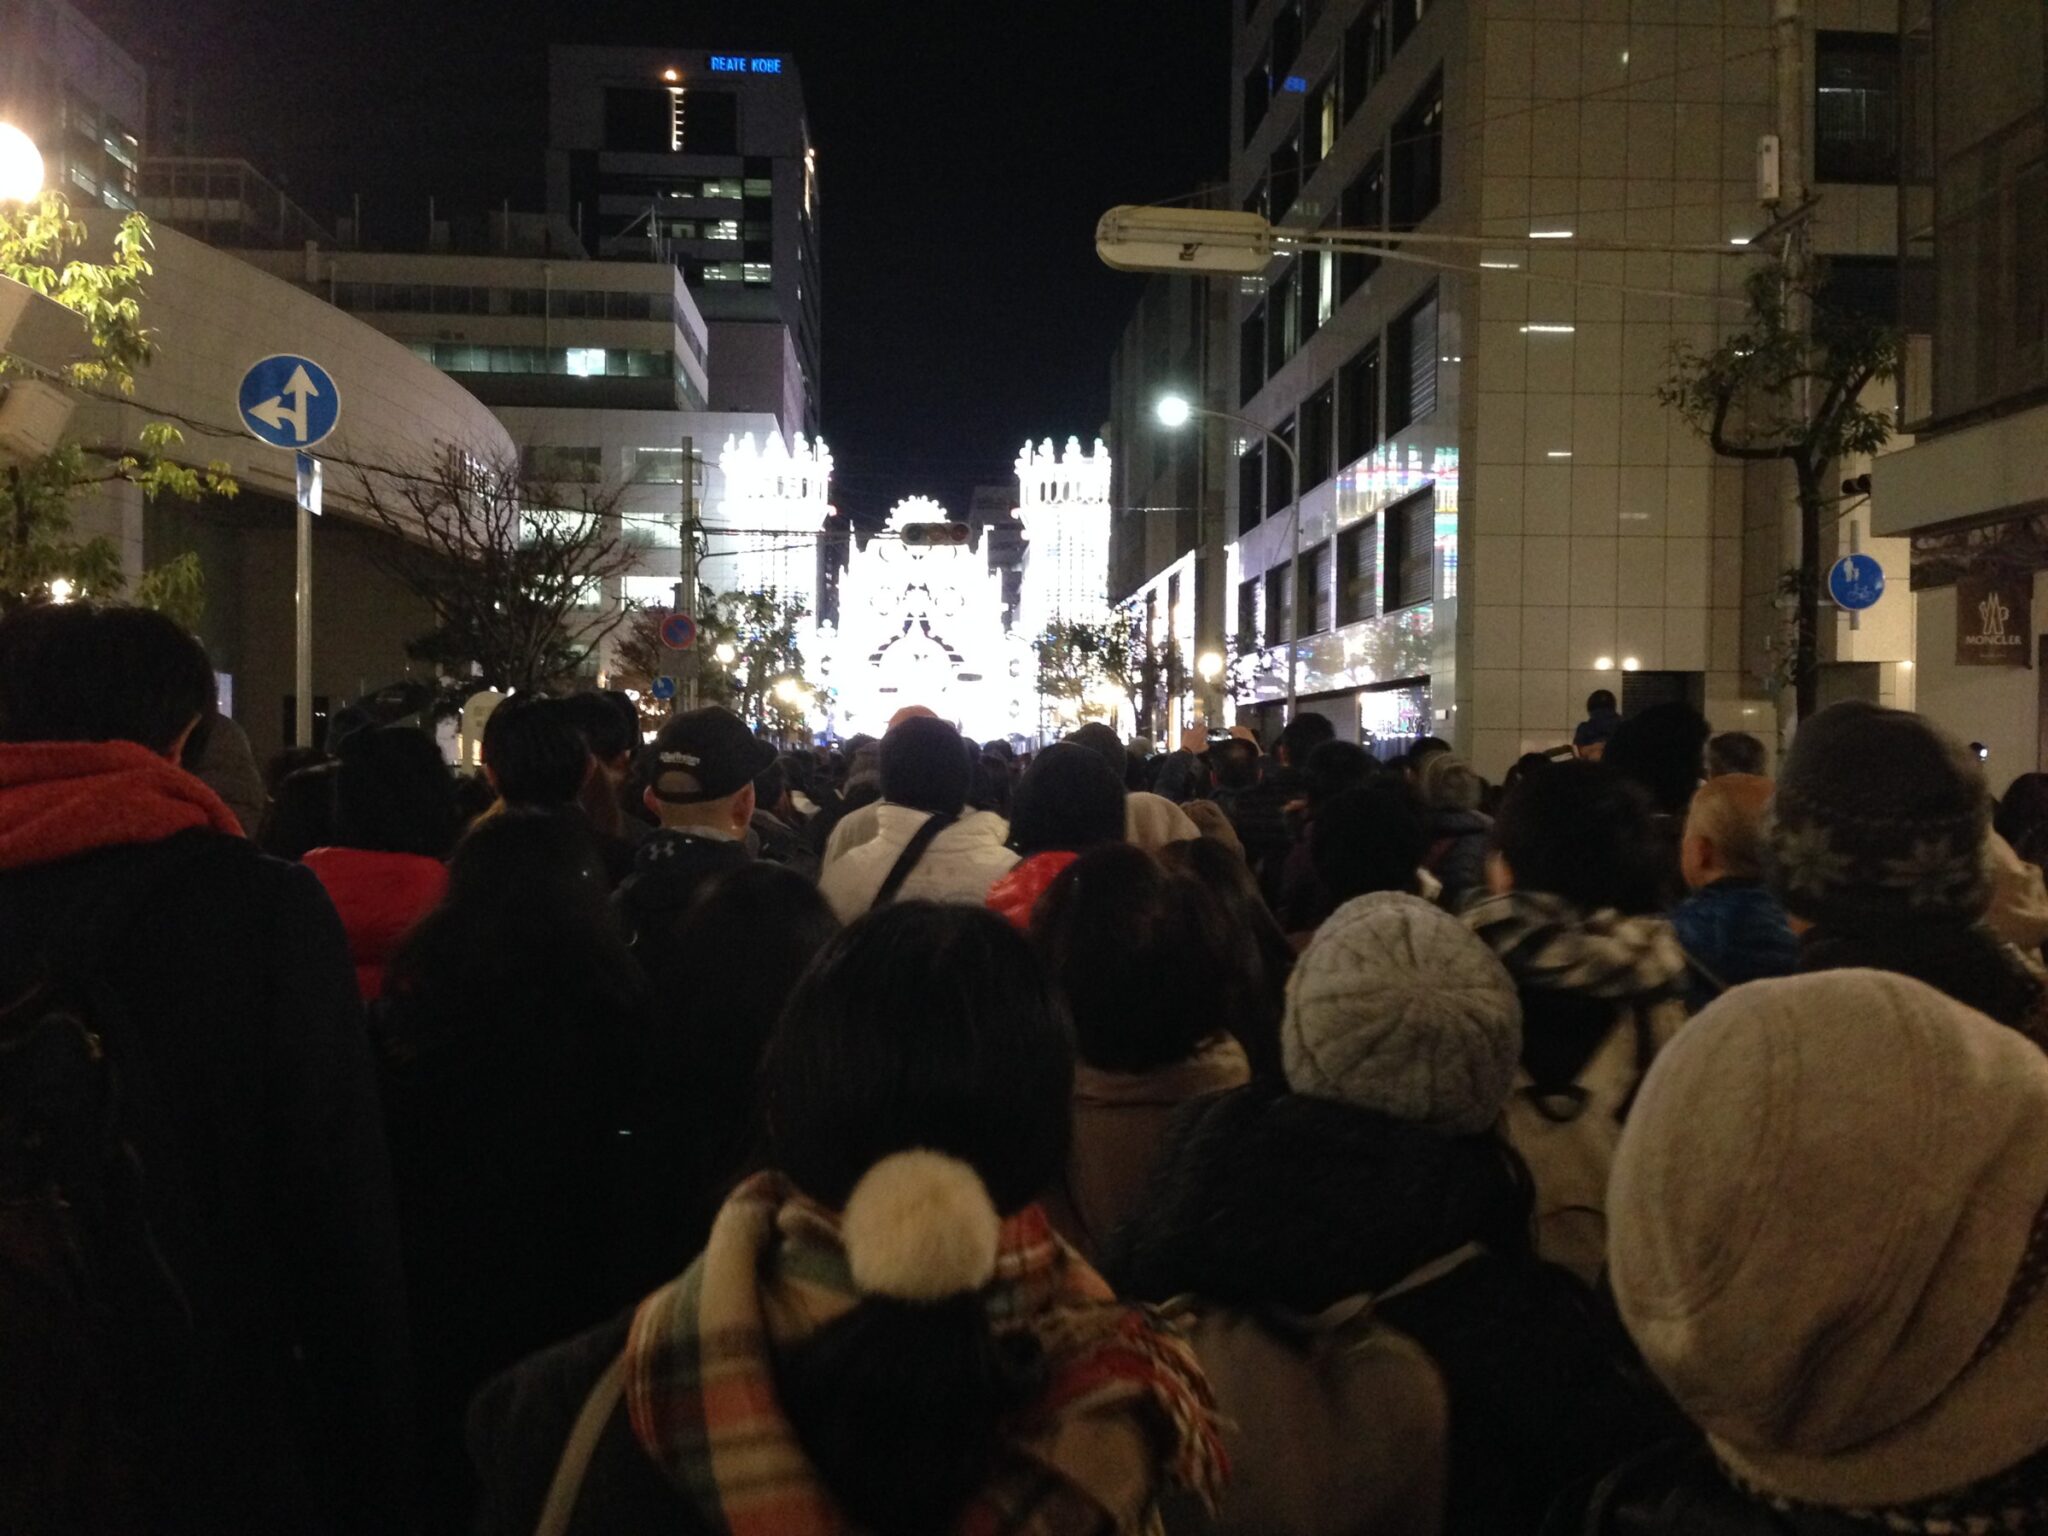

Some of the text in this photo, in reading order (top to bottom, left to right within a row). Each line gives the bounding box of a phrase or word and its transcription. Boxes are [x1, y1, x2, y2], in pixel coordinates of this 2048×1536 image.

[710, 56, 782, 73] REATE KOBE
[1965, 635, 2022, 645] MONCLER
